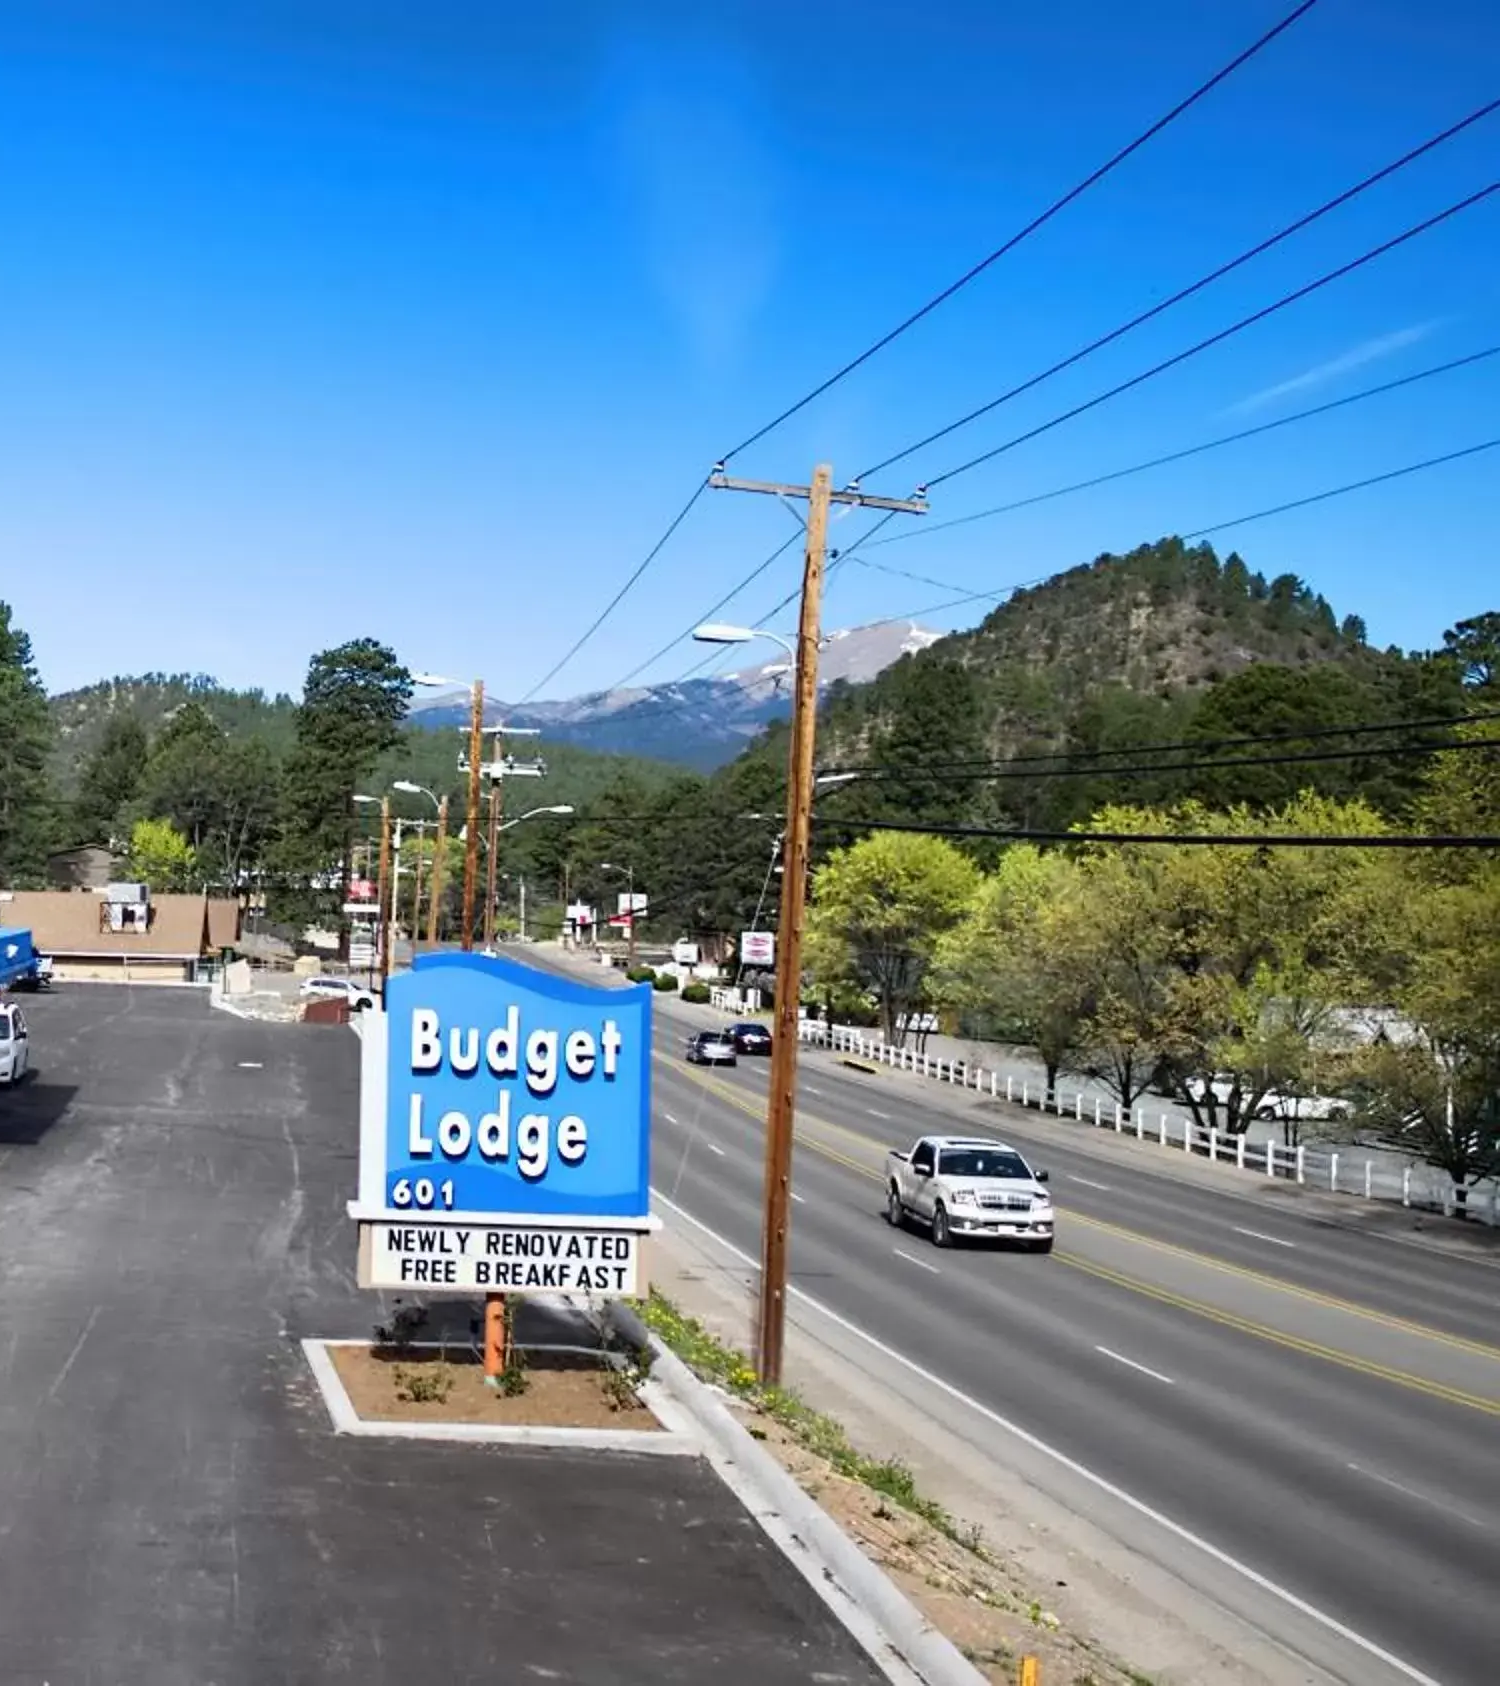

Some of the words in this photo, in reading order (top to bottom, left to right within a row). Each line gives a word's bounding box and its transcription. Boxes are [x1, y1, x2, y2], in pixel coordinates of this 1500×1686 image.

[411, 1005, 622, 1094] Budget
[408, 1089, 589, 1178] Lodge
[392, 1179, 455, 1207] 601
[387, 1228, 470, 1253] NEWLY
[486, 1232, 630, 1260] RENOVATED
[400, 1259, 457, 1283] FREE
[475, 1261, 628, 1290] BREAKFAST
